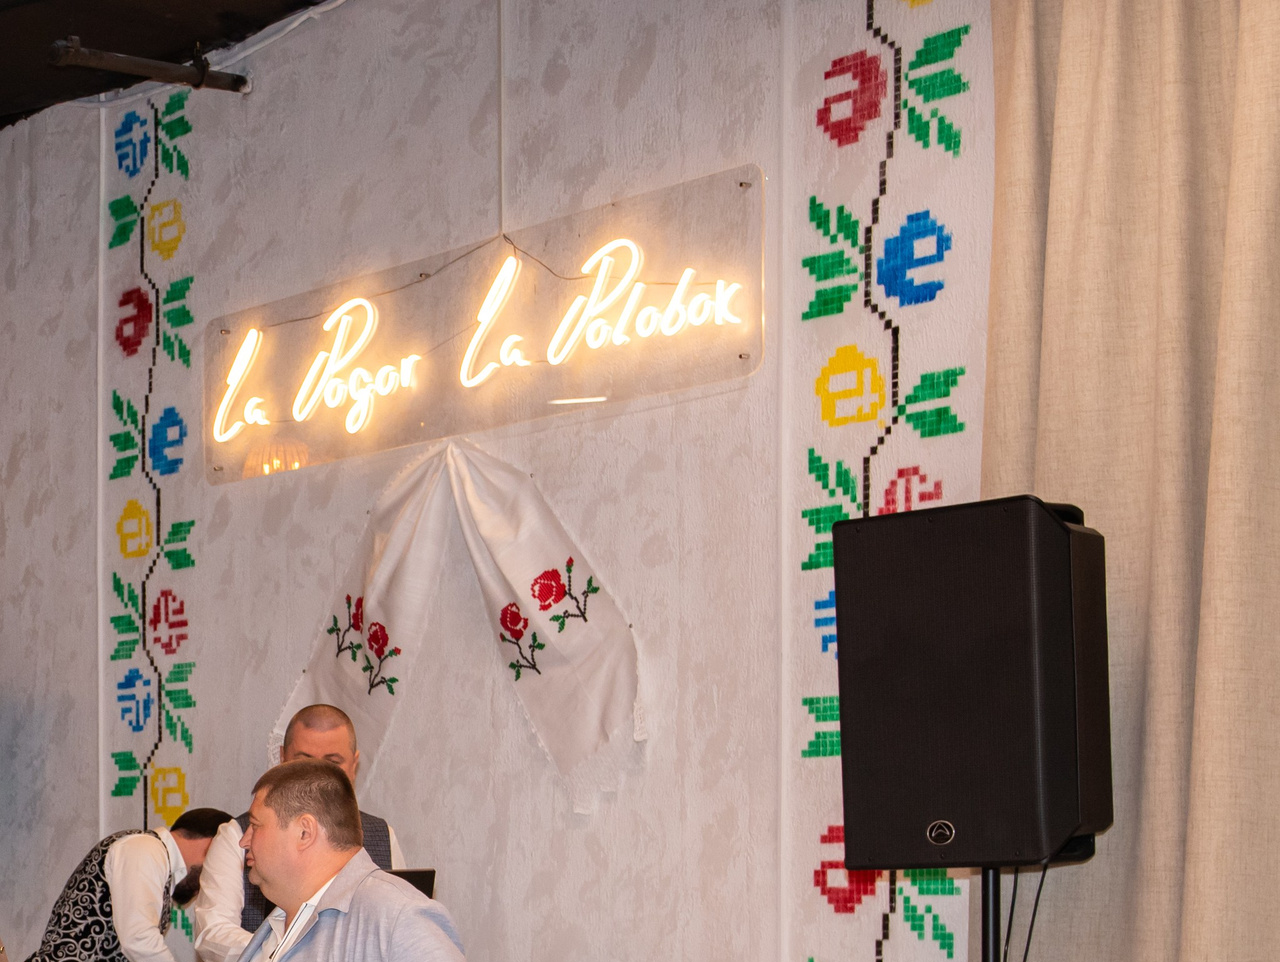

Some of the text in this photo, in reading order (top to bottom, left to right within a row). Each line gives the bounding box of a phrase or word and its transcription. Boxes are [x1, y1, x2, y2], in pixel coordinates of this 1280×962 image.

[212, 328, 270, 443] La
[292, 297, 423, 434] Pogor
[459, 255, 532, 388] La
